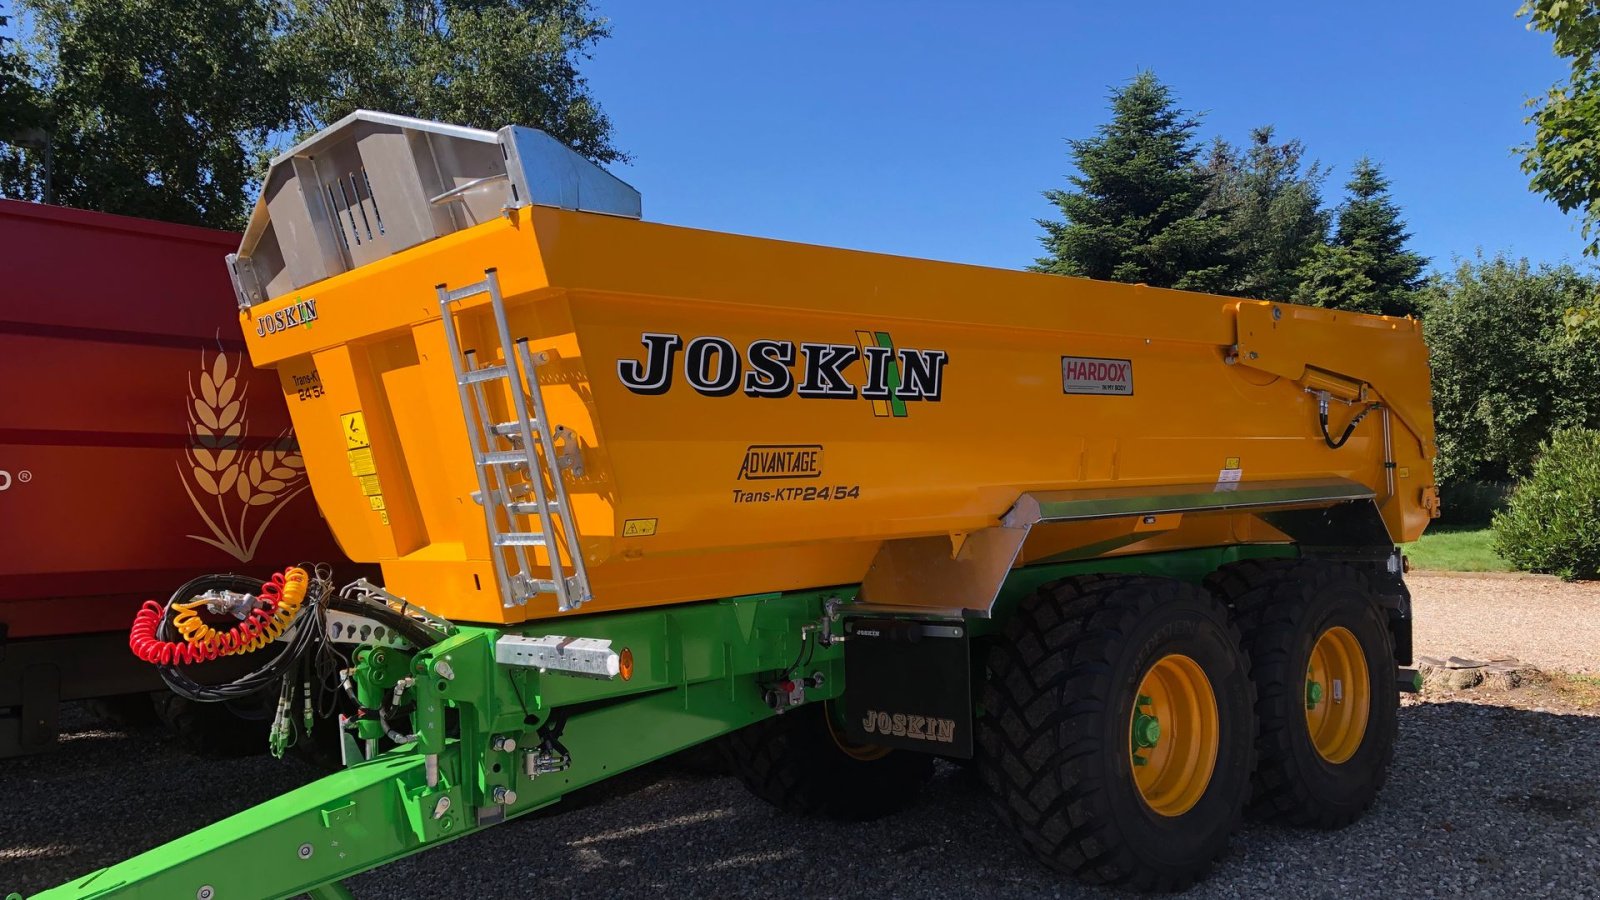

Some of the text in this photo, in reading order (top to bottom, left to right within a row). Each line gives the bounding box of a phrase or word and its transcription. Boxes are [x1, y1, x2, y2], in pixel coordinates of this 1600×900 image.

[257, 298, 318, 337] JOSKIN
[617, 332, 948, 402] JOSKIN
[737, 451, 817, 480] ADVANTAGE
[862, 710, 956, 743] JOSKIN
